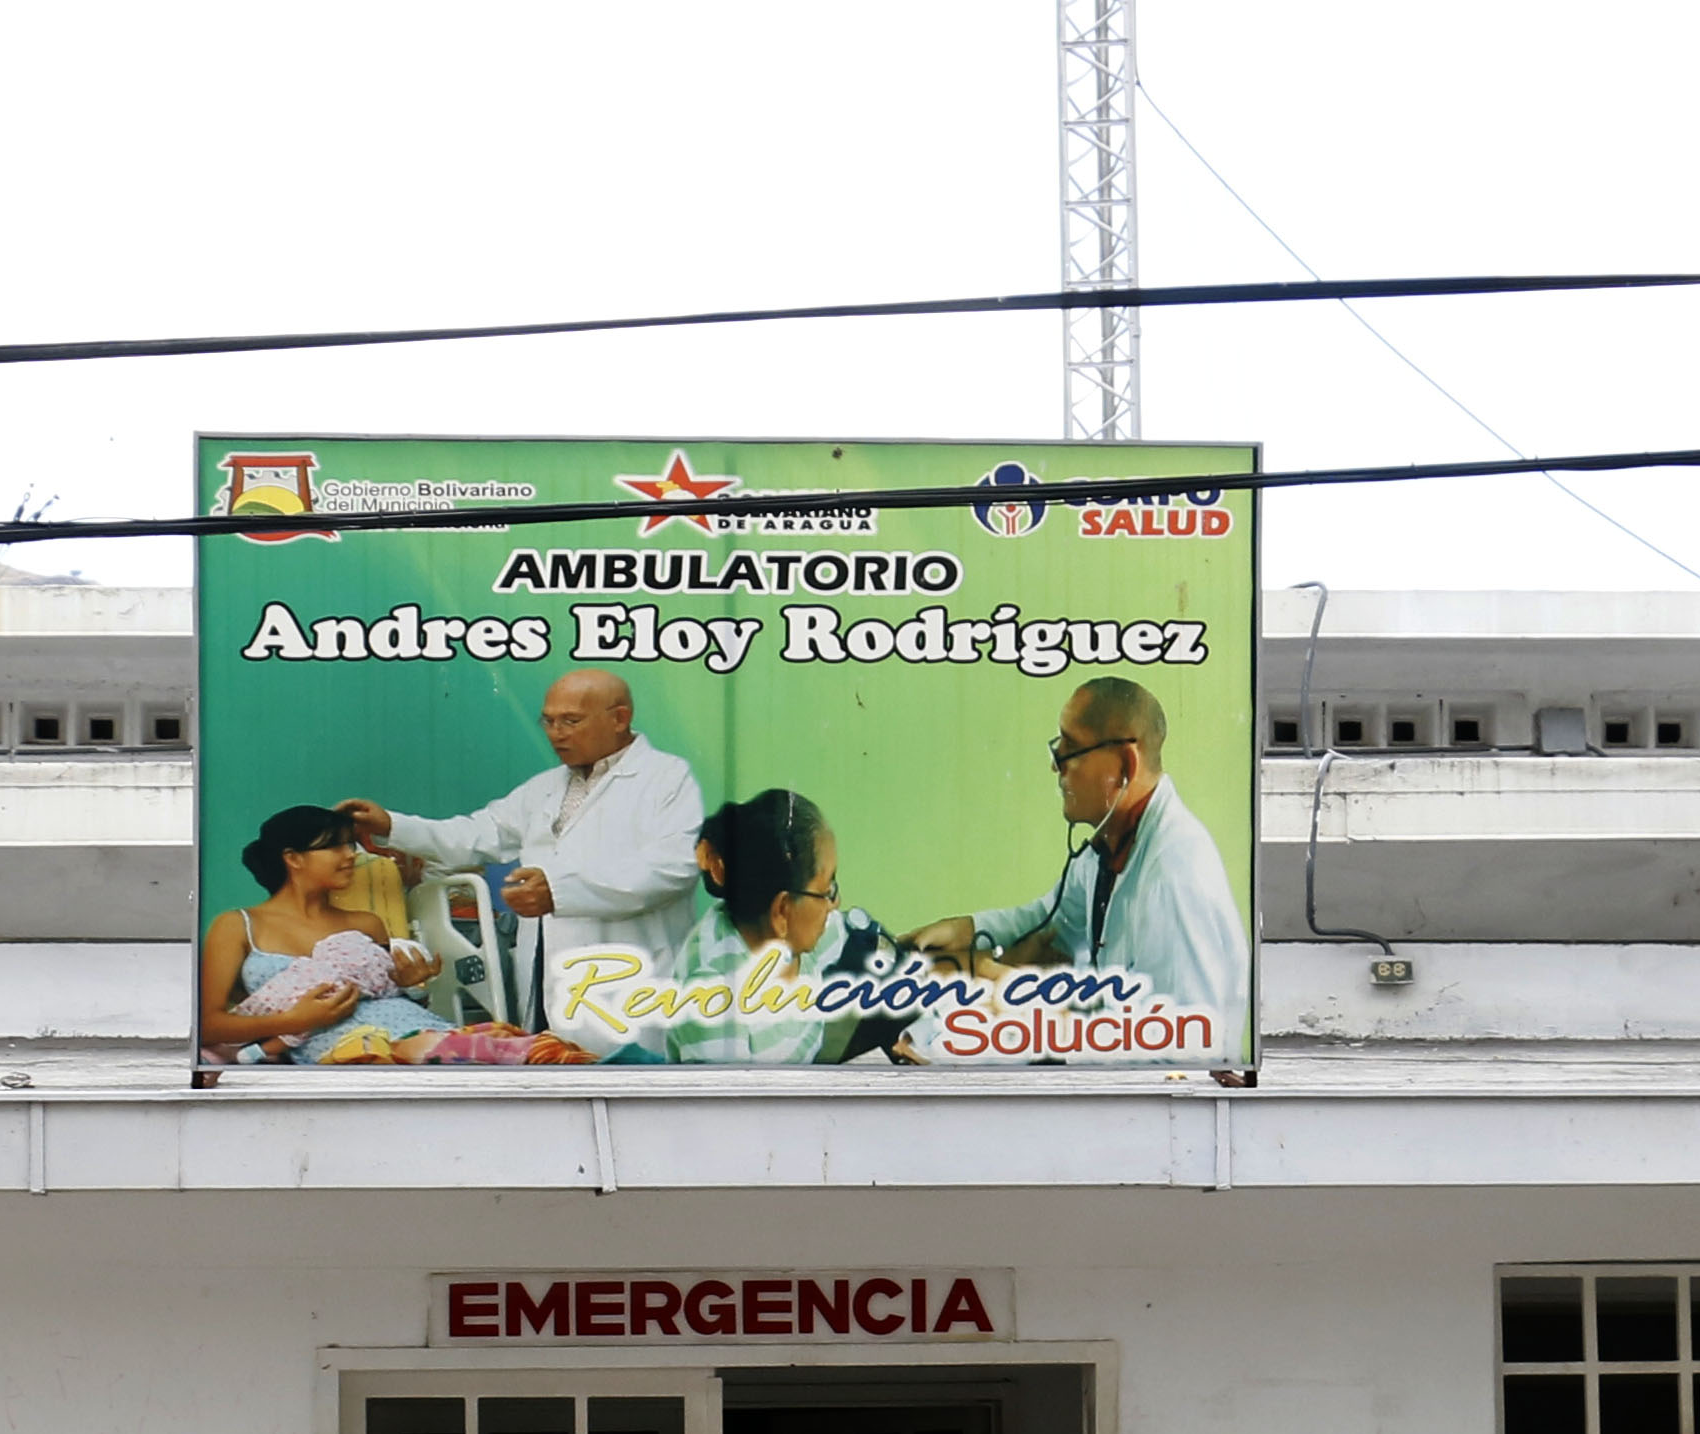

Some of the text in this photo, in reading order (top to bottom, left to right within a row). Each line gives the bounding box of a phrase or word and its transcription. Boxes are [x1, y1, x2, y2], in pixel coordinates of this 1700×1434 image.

[324, 482, 532, 498] Gobierno Bolivariano
[326, 500, 354, 512] del
[718, 519, 872, 530] DE ARAGUA
[1081, 509, 1231, 536] SALUD
[501, 553, 956, 591] AMBULATORIO
[244, 603, 1206, 674] Andres Eloy Rodríguez
[563, 950, 1141, 1034] Revolución con
[943, 1004, 1212, 1056] Solución
[449, 1278, 994, 1338] EMERGENCIA
